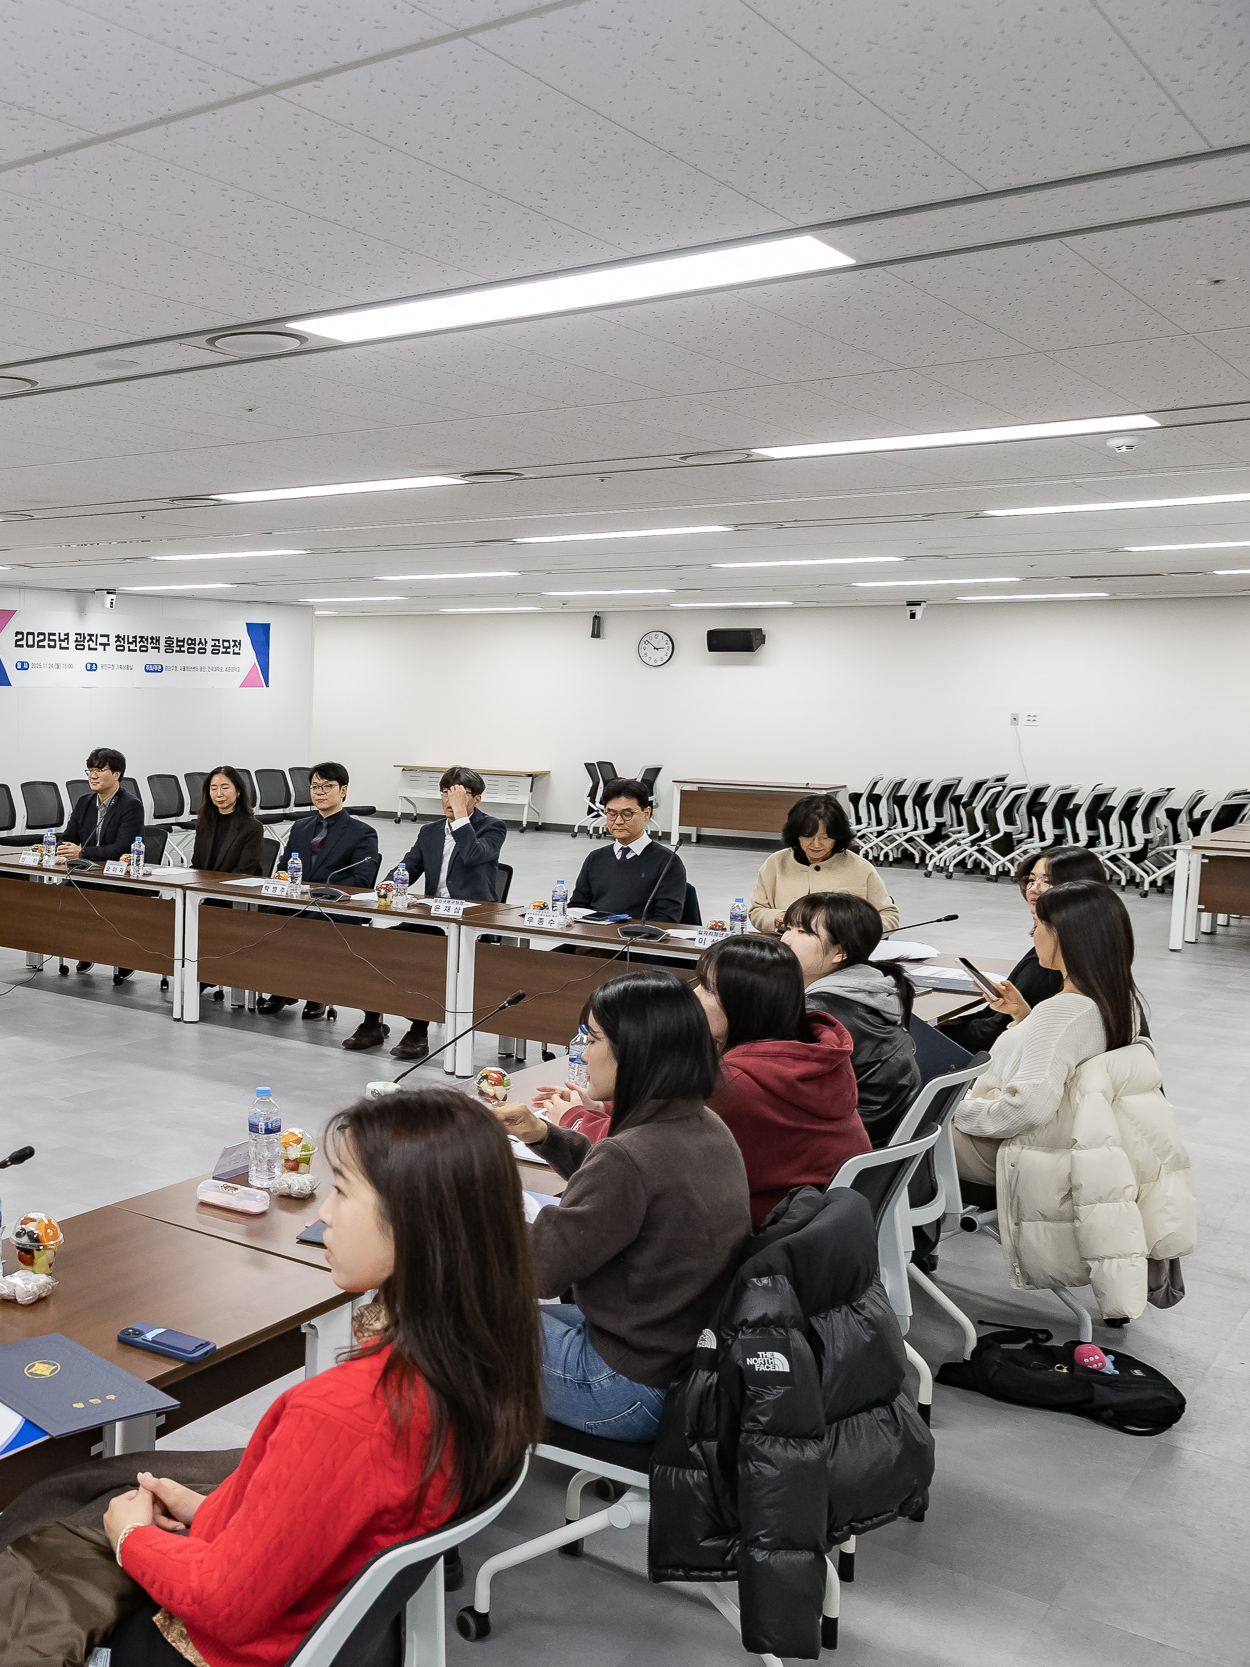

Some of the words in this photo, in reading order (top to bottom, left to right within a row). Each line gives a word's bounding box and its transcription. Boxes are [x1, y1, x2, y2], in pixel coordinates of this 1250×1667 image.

[14, 630, 70, 651] 2025년
[74, 632, 111, 652] 광진구
[114, 633, 161, 654] 청년정책
[163, 636, 208, 656] 홍보영상
[211, 638, 242, 656] 공모전
[746, 1357, 775, 1366] NORTH
[755, 1364, 776, 1372] FACE
